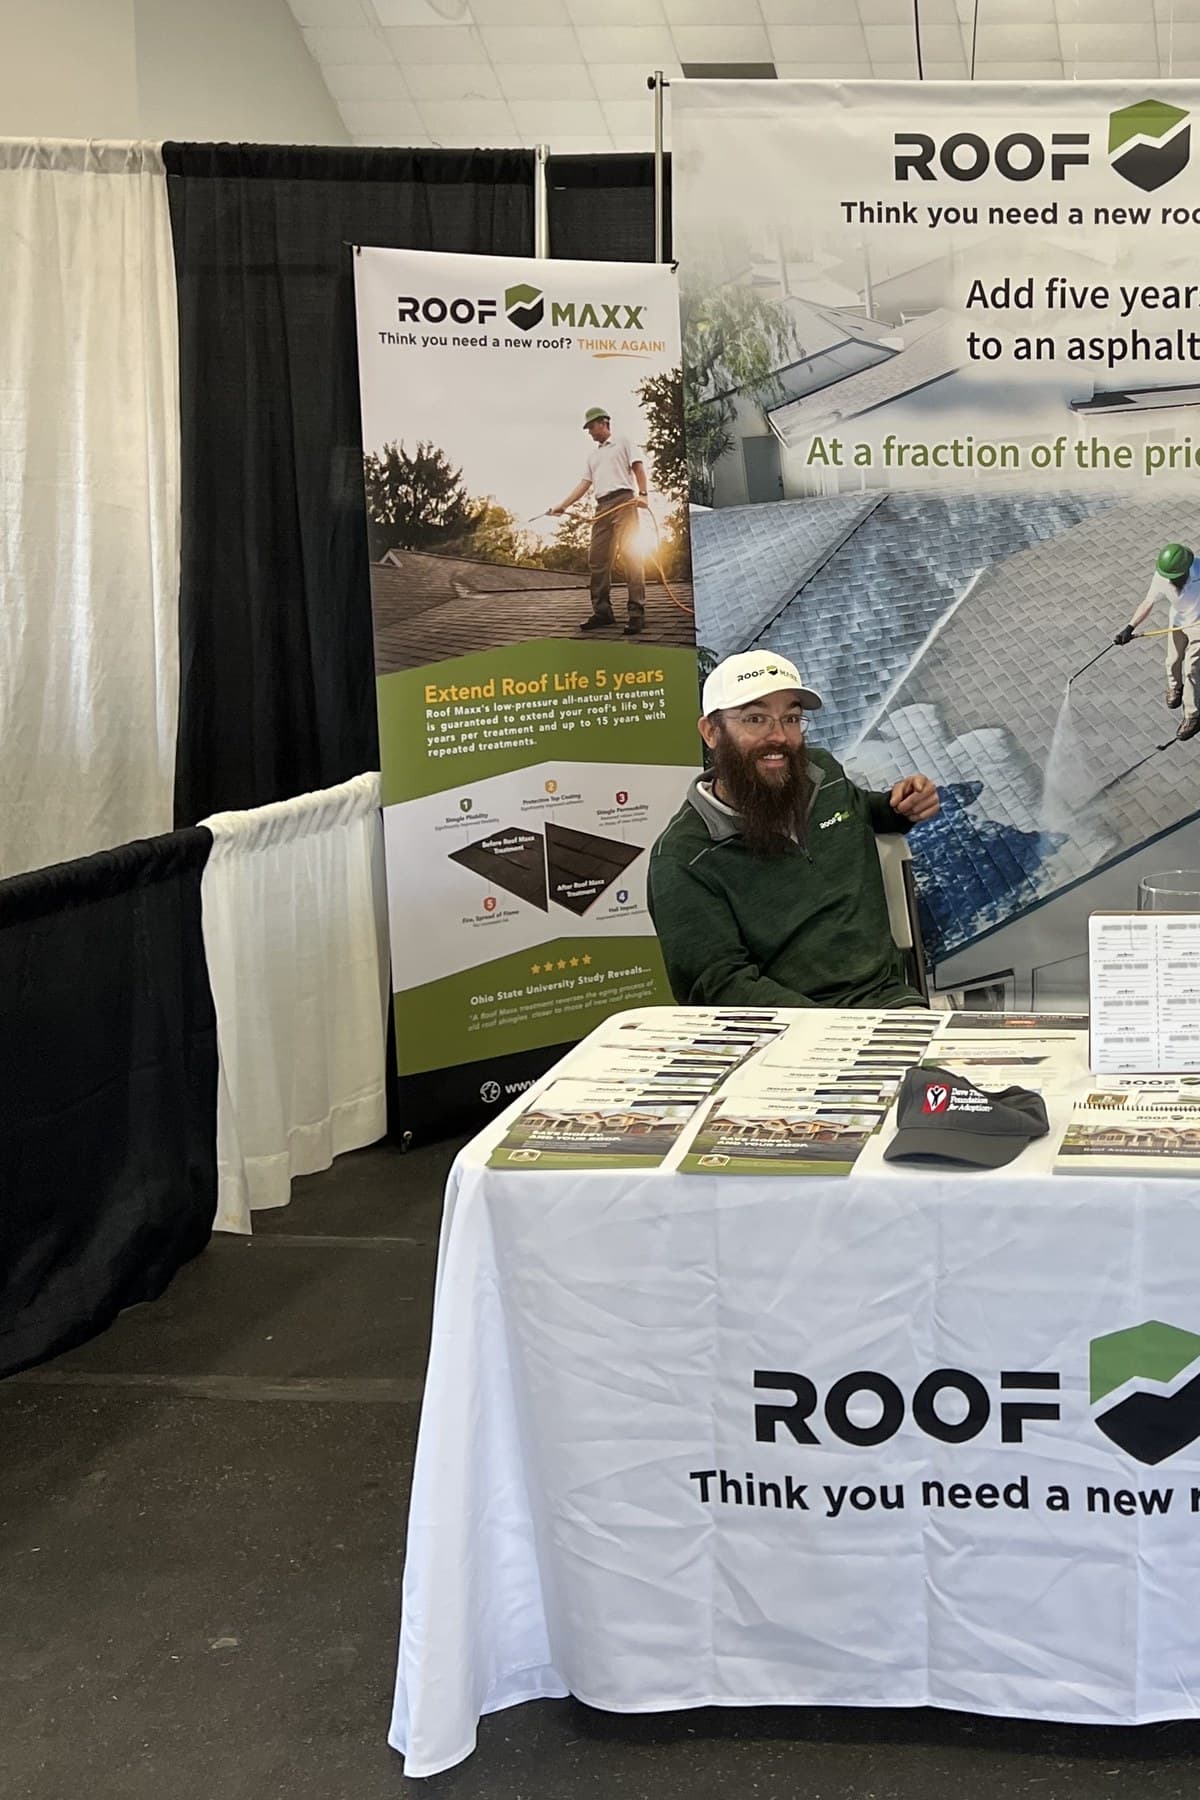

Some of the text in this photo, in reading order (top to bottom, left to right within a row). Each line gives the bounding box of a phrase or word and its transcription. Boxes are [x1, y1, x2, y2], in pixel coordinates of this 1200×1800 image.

[893, 132, 1090, 182] ROOF
[840, 201, 918, 225] Think
[927, 207, 978, 229] you
[988, 202, 1058, 225] need
[1067, 207, 1084, 225] a
[1094, 207, 1152, 225] new
[965, 278, 1034, 309] Add
[1046, 277, 1110, 309] five
[397, 296, 497, 325] ROOF
[378, 331, 666, 353] Think you need a new roof? THINK AGAIN!
[966, 330, 1002, 361] to
[1013, 336, 1056, 361] an
[806, 436, 843, 466] At
[854, 443, 873, 467] a
[883, 434, 1019, 468] fraction
[1031, 436, 1068, 468] of
[1075, 437, 1133, 468] the
[424, 669, 665, 704] Extend Roof Life 5 years
[737, 669, 765, 682] ROOF
[426, 687, 665, 719] Roof Maxx's low-pressure all-natural treatment
[426, 699, 666, 733] is guaranteed to extend your roof's life by 5
[427, 710, 666, 747] years per treatment and up to 15 years with
[427, 737, 538, 758] repeated treatments.
[470, 995, 495, 1006] Ohio
[497, 989, 523, 1001] State
[526, 978, 575, 997] University
[577, 973, 605, 986] Study
[753, 1368, 1061, 1447] ROOF
[689, 1469, 810, 1511] Think
[823, 1483, 905, 1518] you
[921, 1475, 1030, 1510] need
[1046, 1485, 1070, 1511] a
[1086, 1486, 1174, 1517] new
